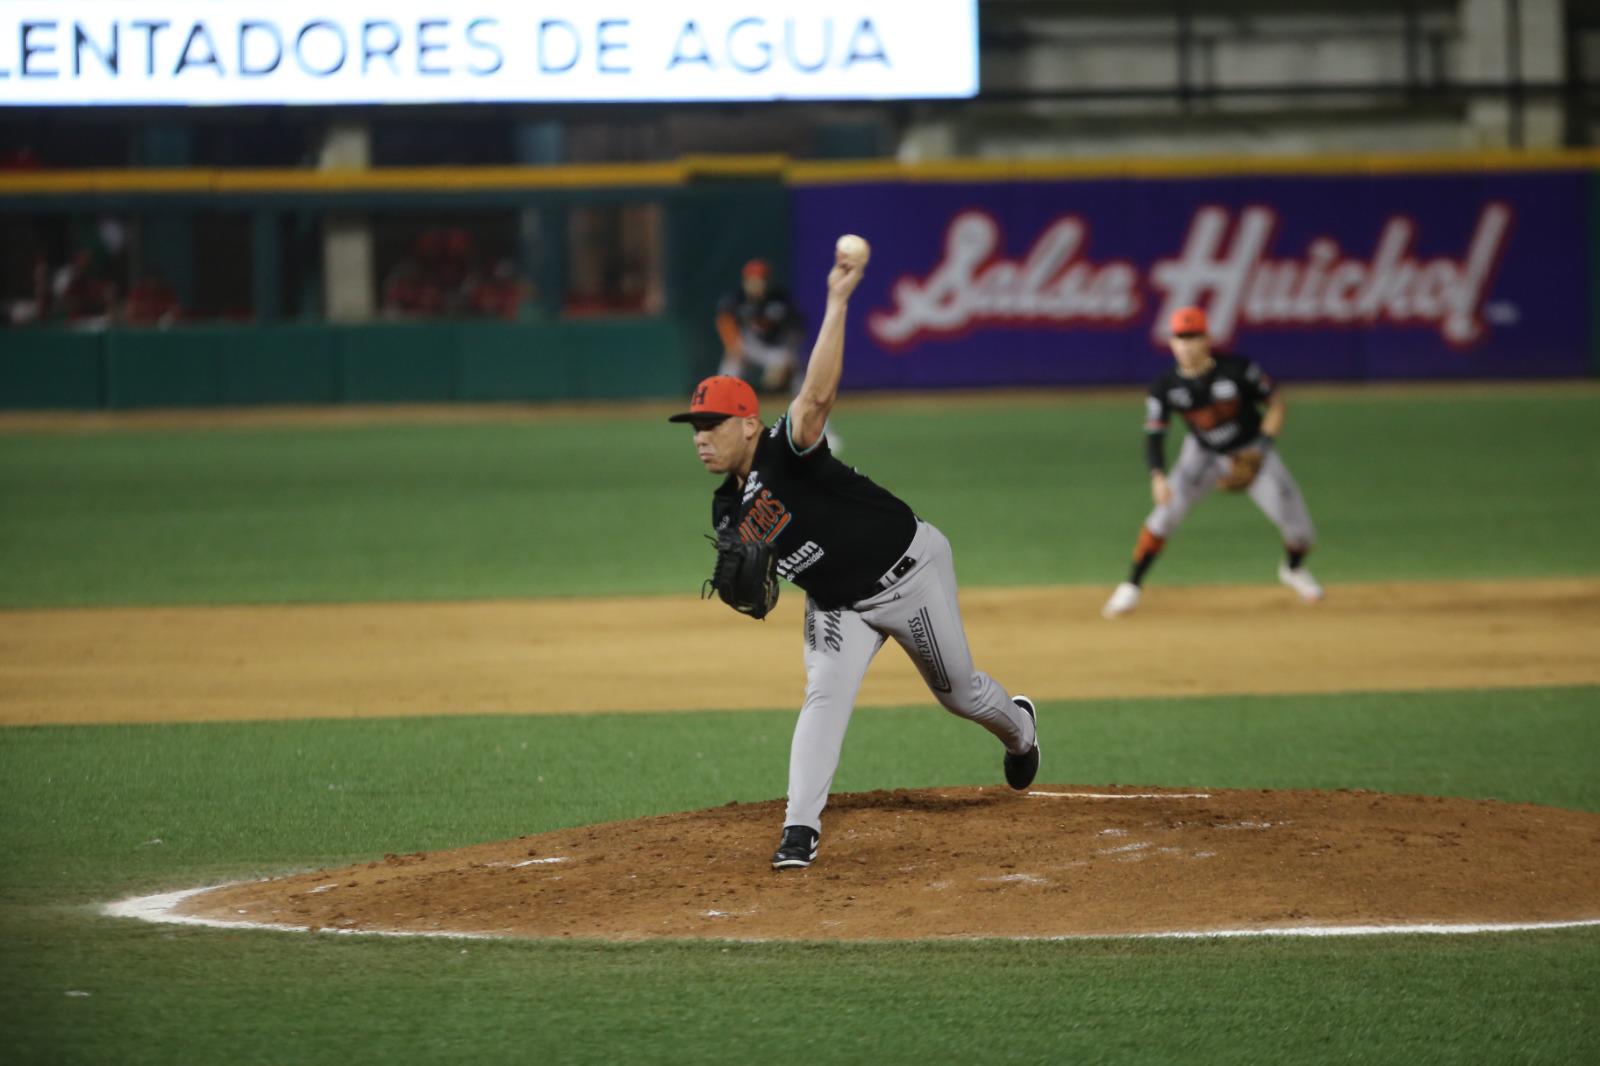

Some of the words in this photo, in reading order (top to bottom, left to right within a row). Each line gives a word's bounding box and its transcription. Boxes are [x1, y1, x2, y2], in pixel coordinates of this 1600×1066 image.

[0, 18, 503, 79] ENTADORES
[537, 17, 632, 74] DE
[665, 15, 892, 74] AGUA
[867, 207, 1138, 346] Salsa
